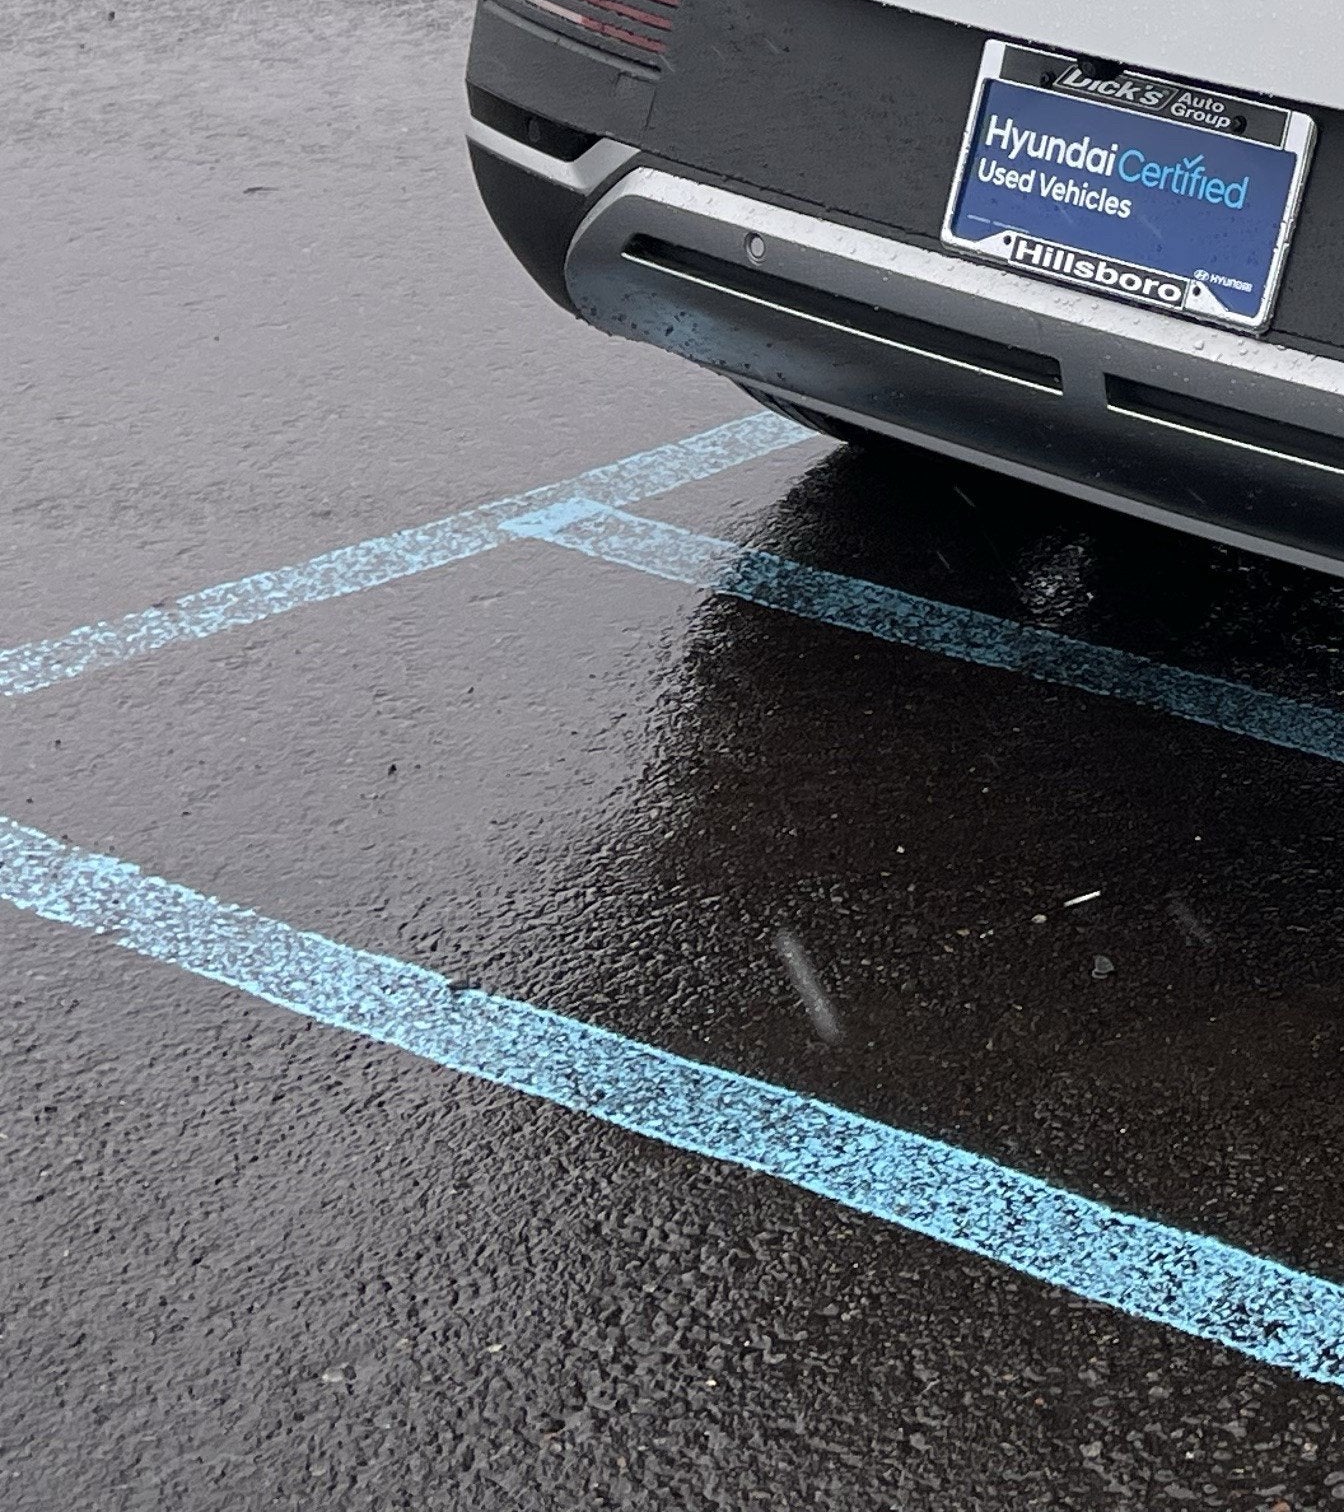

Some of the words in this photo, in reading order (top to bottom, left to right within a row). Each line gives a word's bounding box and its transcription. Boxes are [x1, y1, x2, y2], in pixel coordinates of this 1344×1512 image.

[1170, 102, 1232, 129] Group
[1178, 92, 1226, 114] Auto
[978, 157, 1036, 193] Used
[1039, 172, 1132, 219] Vehicles
[984, 114, 1119, 177] Hyundai
[1118, 148, 1250, 210] Certified
[1015, 240, 1182, 302] Hillsboro
